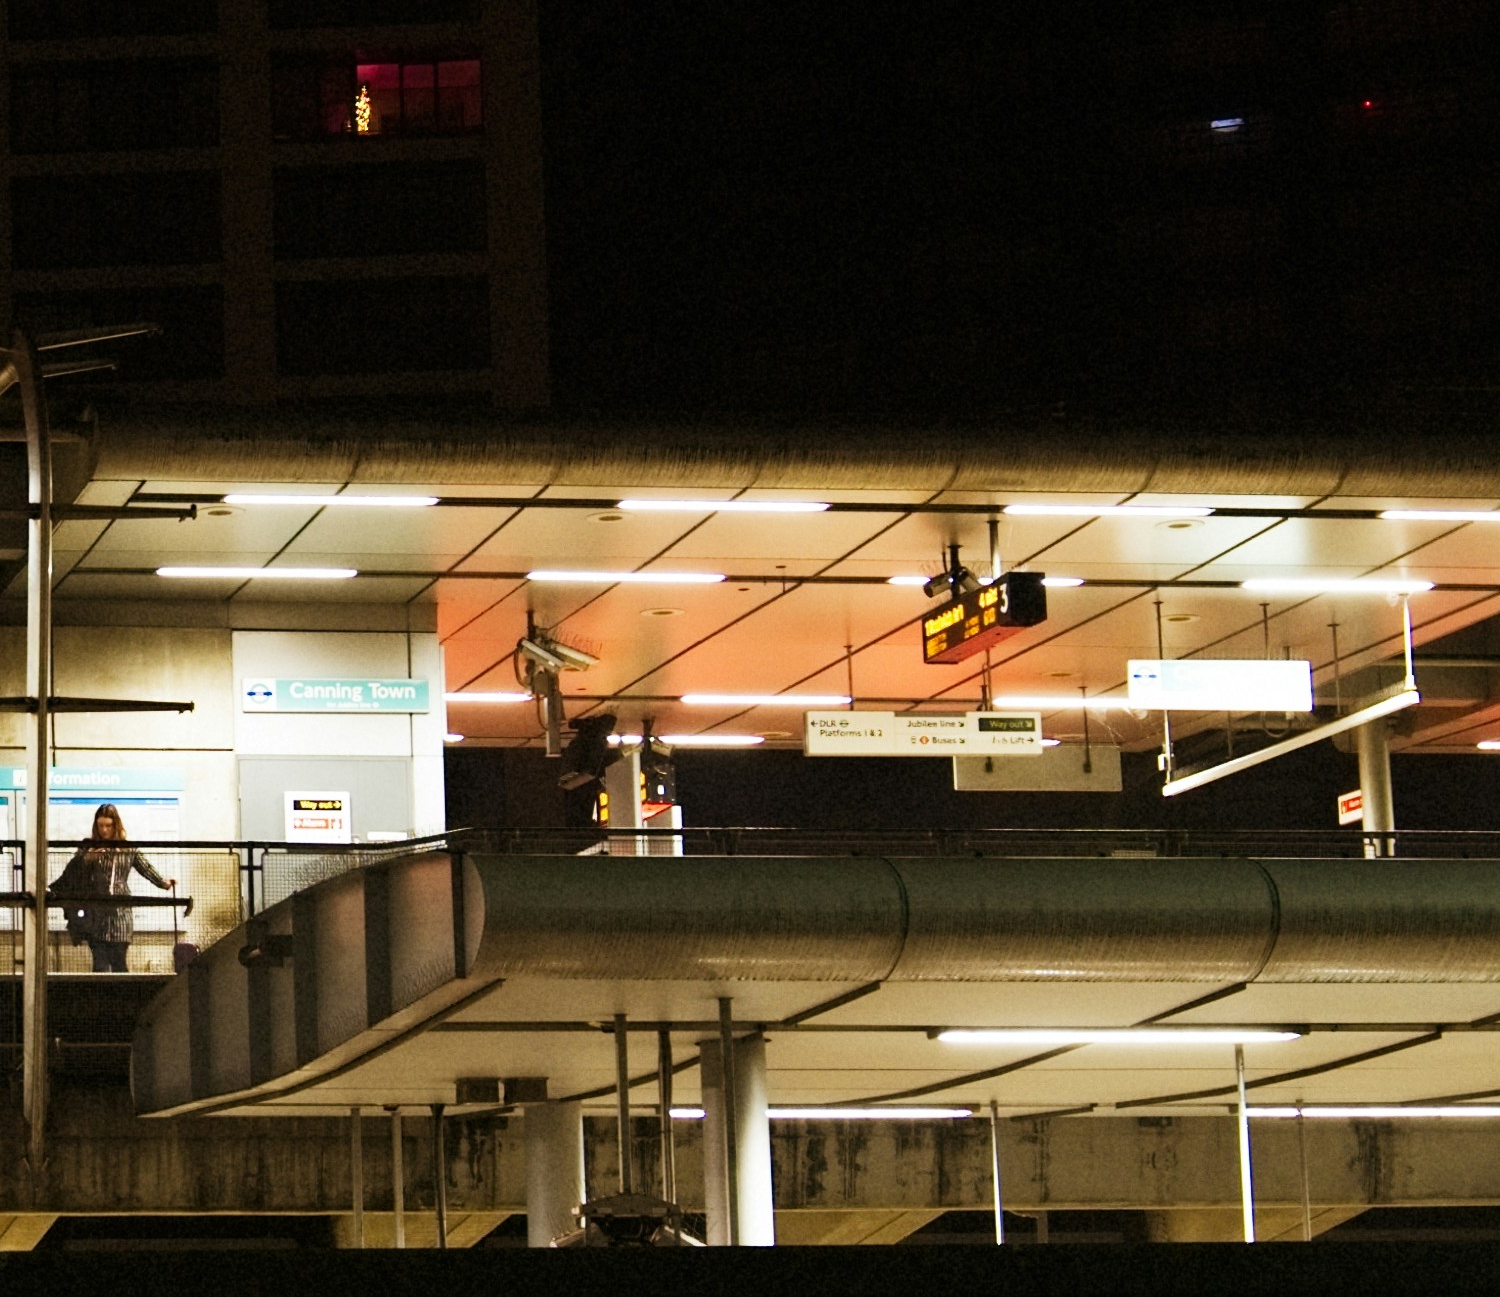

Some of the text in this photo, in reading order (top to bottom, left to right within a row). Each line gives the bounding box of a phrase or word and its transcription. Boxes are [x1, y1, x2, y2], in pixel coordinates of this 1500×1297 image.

[999, 583, 1009, 614] 3
[290, 682, 416, 701] Canning Town
[820, 720, 837, 728] DLR
[907, 720, 956, 728] Jubilee line
[990, 720, 1007, 729] Way
[820, 729, 862, 737] Platforms
[932, 736, 957, 744] Buses
[1010, 736, 1026, 744] Lift
[49, 770, 121, 786] formation
[300, 800, 318, 810] Way
